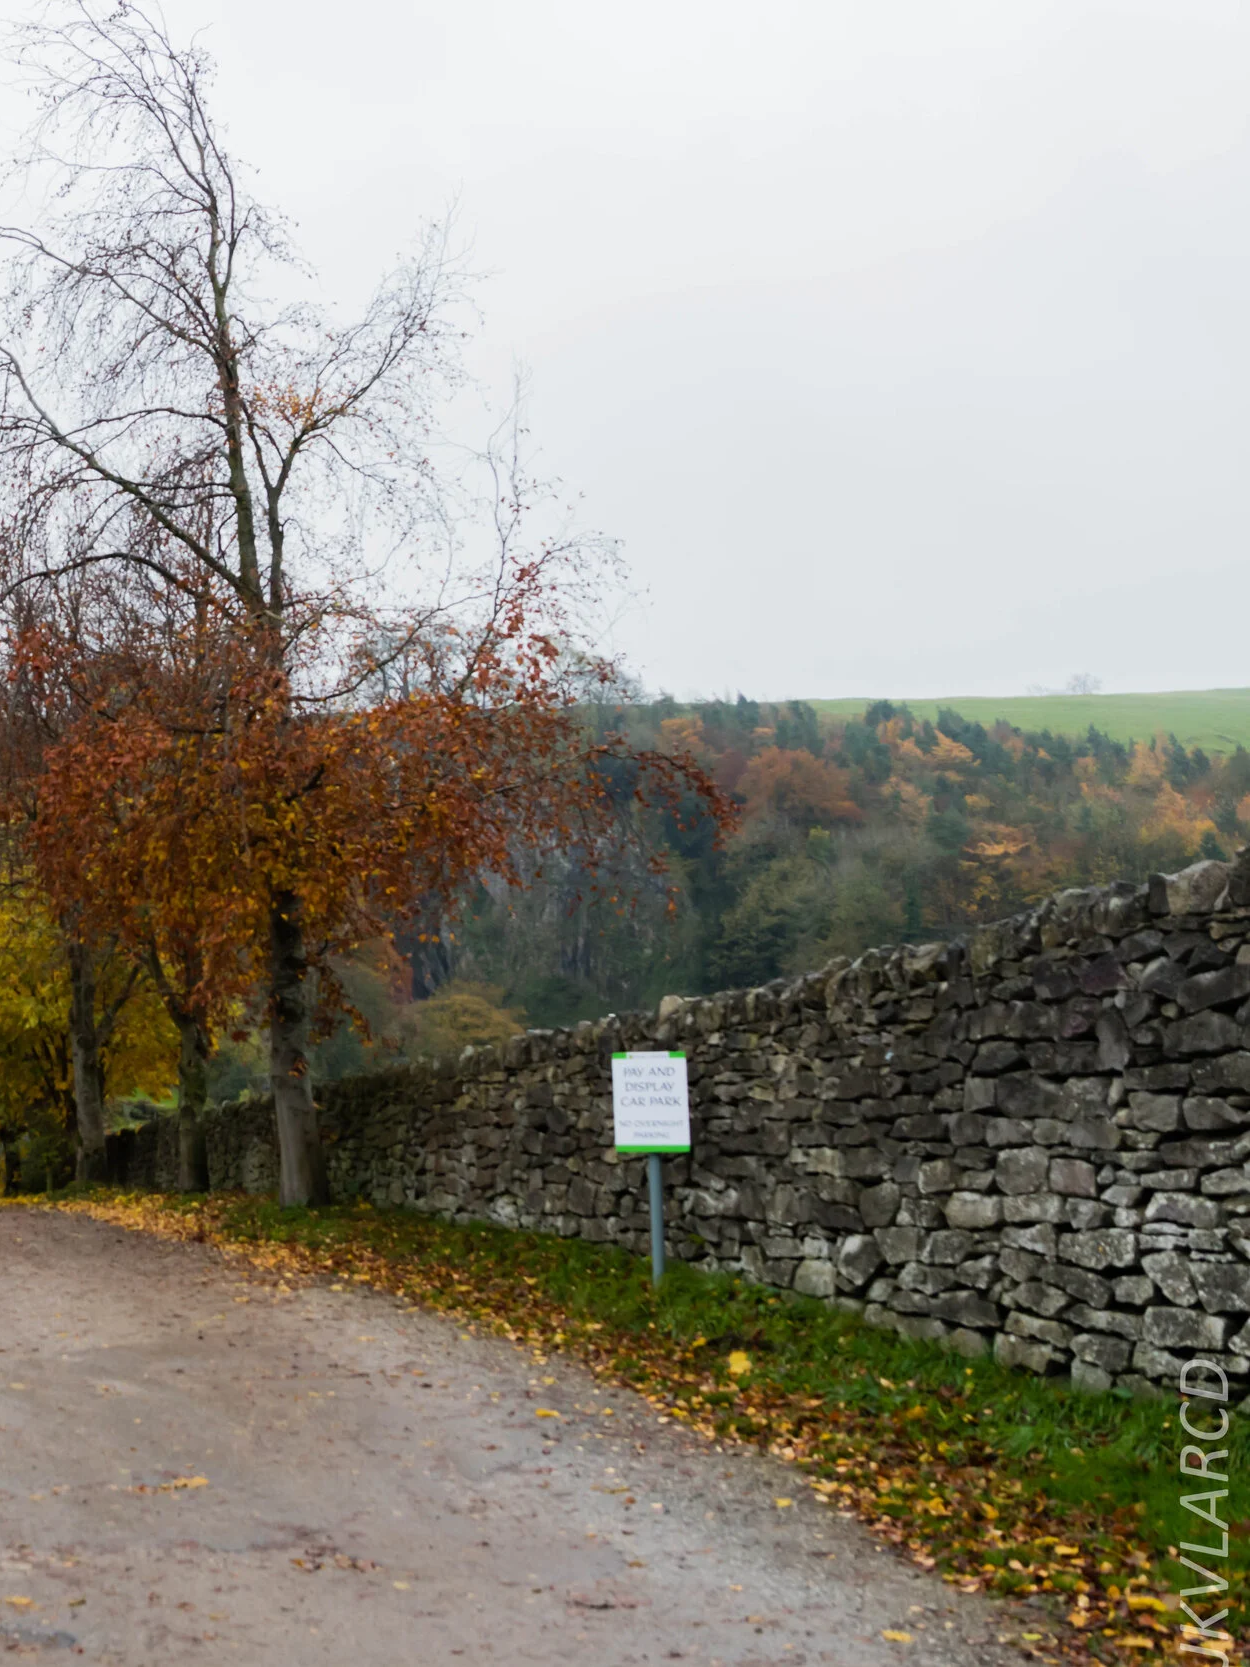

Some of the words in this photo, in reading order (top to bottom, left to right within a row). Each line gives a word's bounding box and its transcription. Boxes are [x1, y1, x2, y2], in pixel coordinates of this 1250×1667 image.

[623, 1067, 644, 1077] PAY
[649, 1067, 676, 1076] AND
[625, 1082, 675, 1092] DISPLAY
[620, 1096, 646, 1107] CAR
[649, 1096, 682, 1106] PARK
